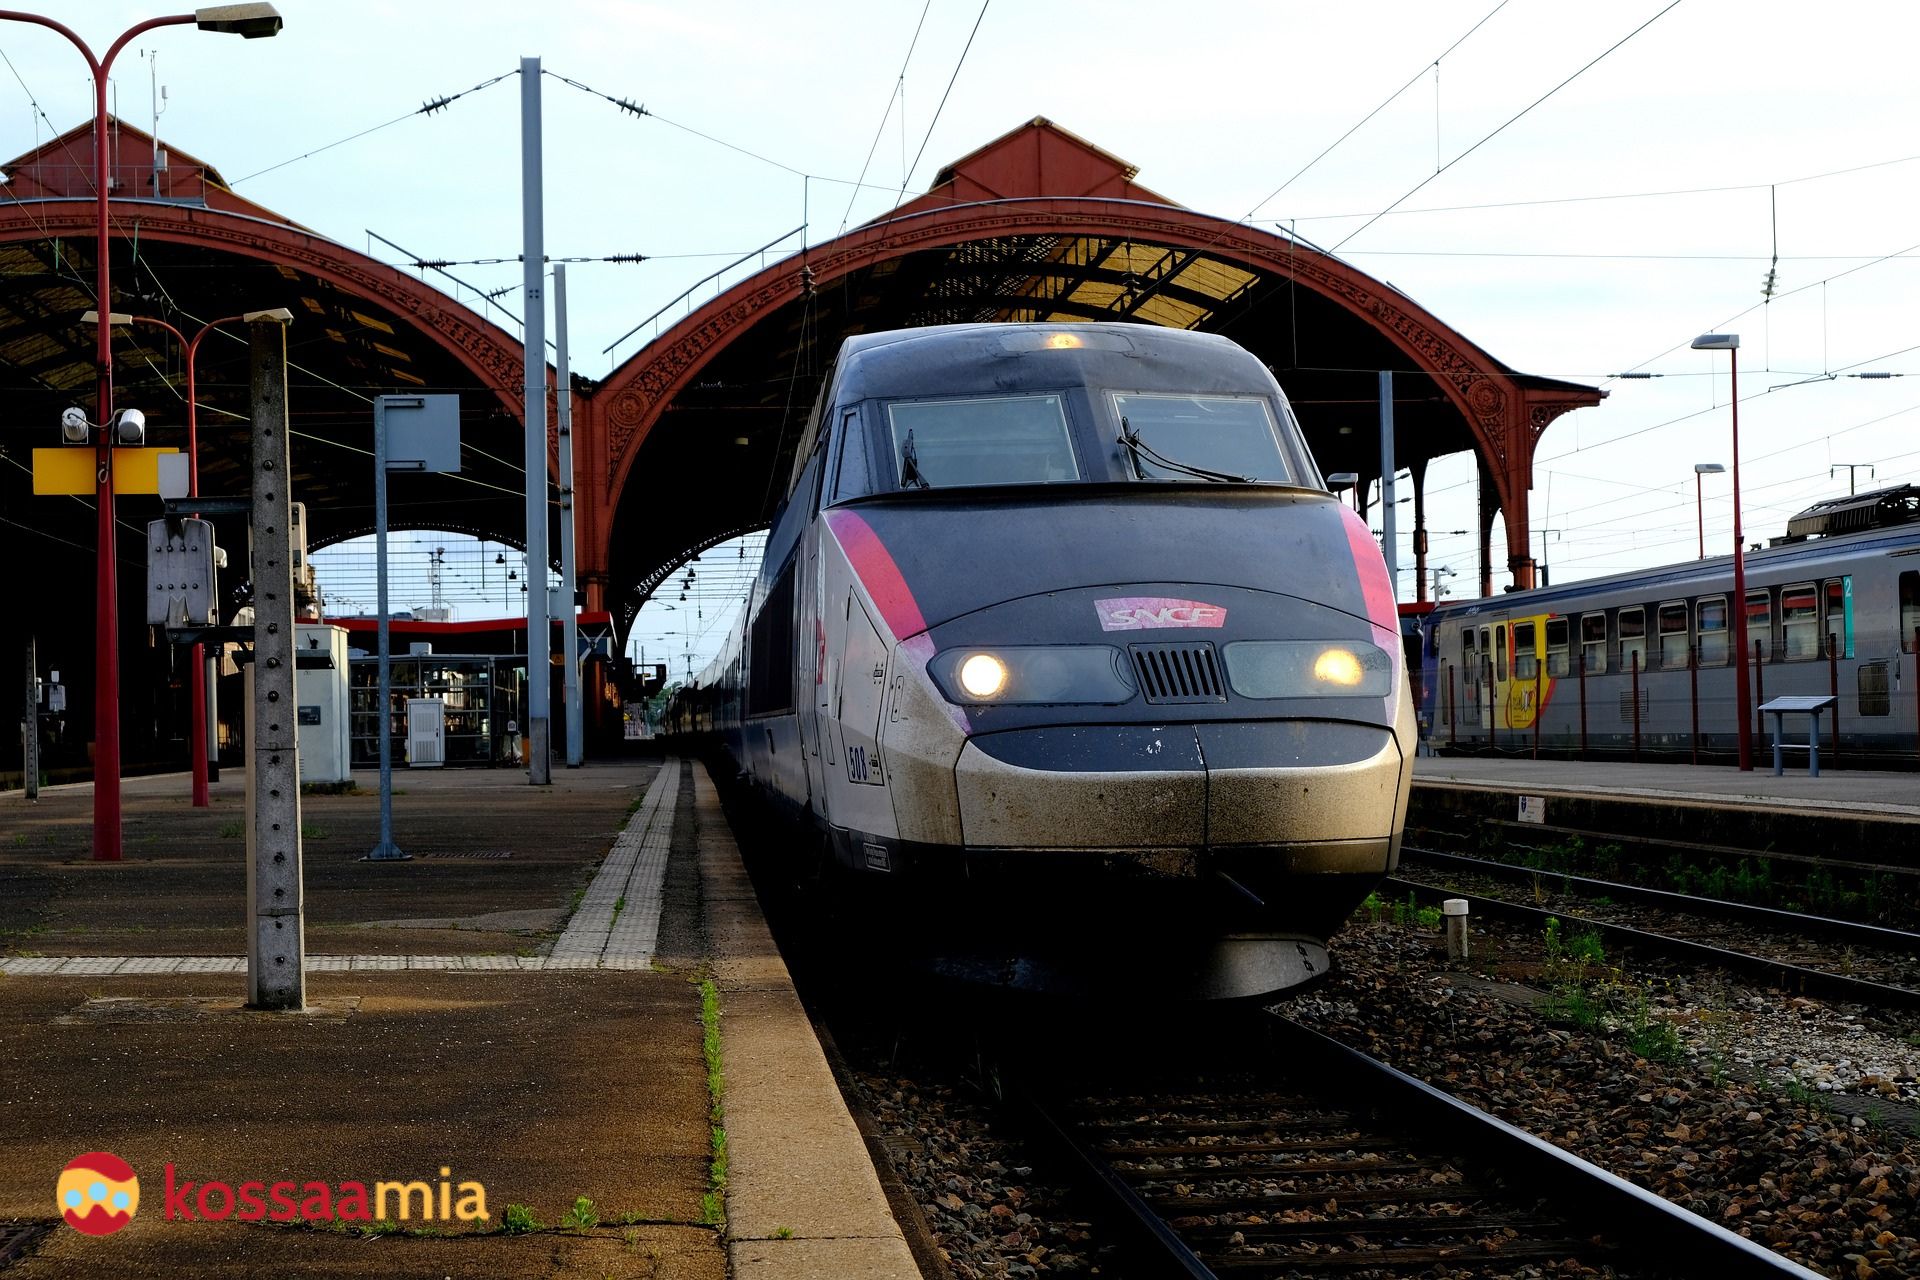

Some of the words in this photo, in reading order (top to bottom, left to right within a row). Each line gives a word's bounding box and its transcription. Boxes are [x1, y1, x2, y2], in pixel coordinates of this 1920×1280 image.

[1845, 578, 1851, 597] 2
[1108, 607, 1219, 626] SNCF
[849, 745, 867, 781] 508
